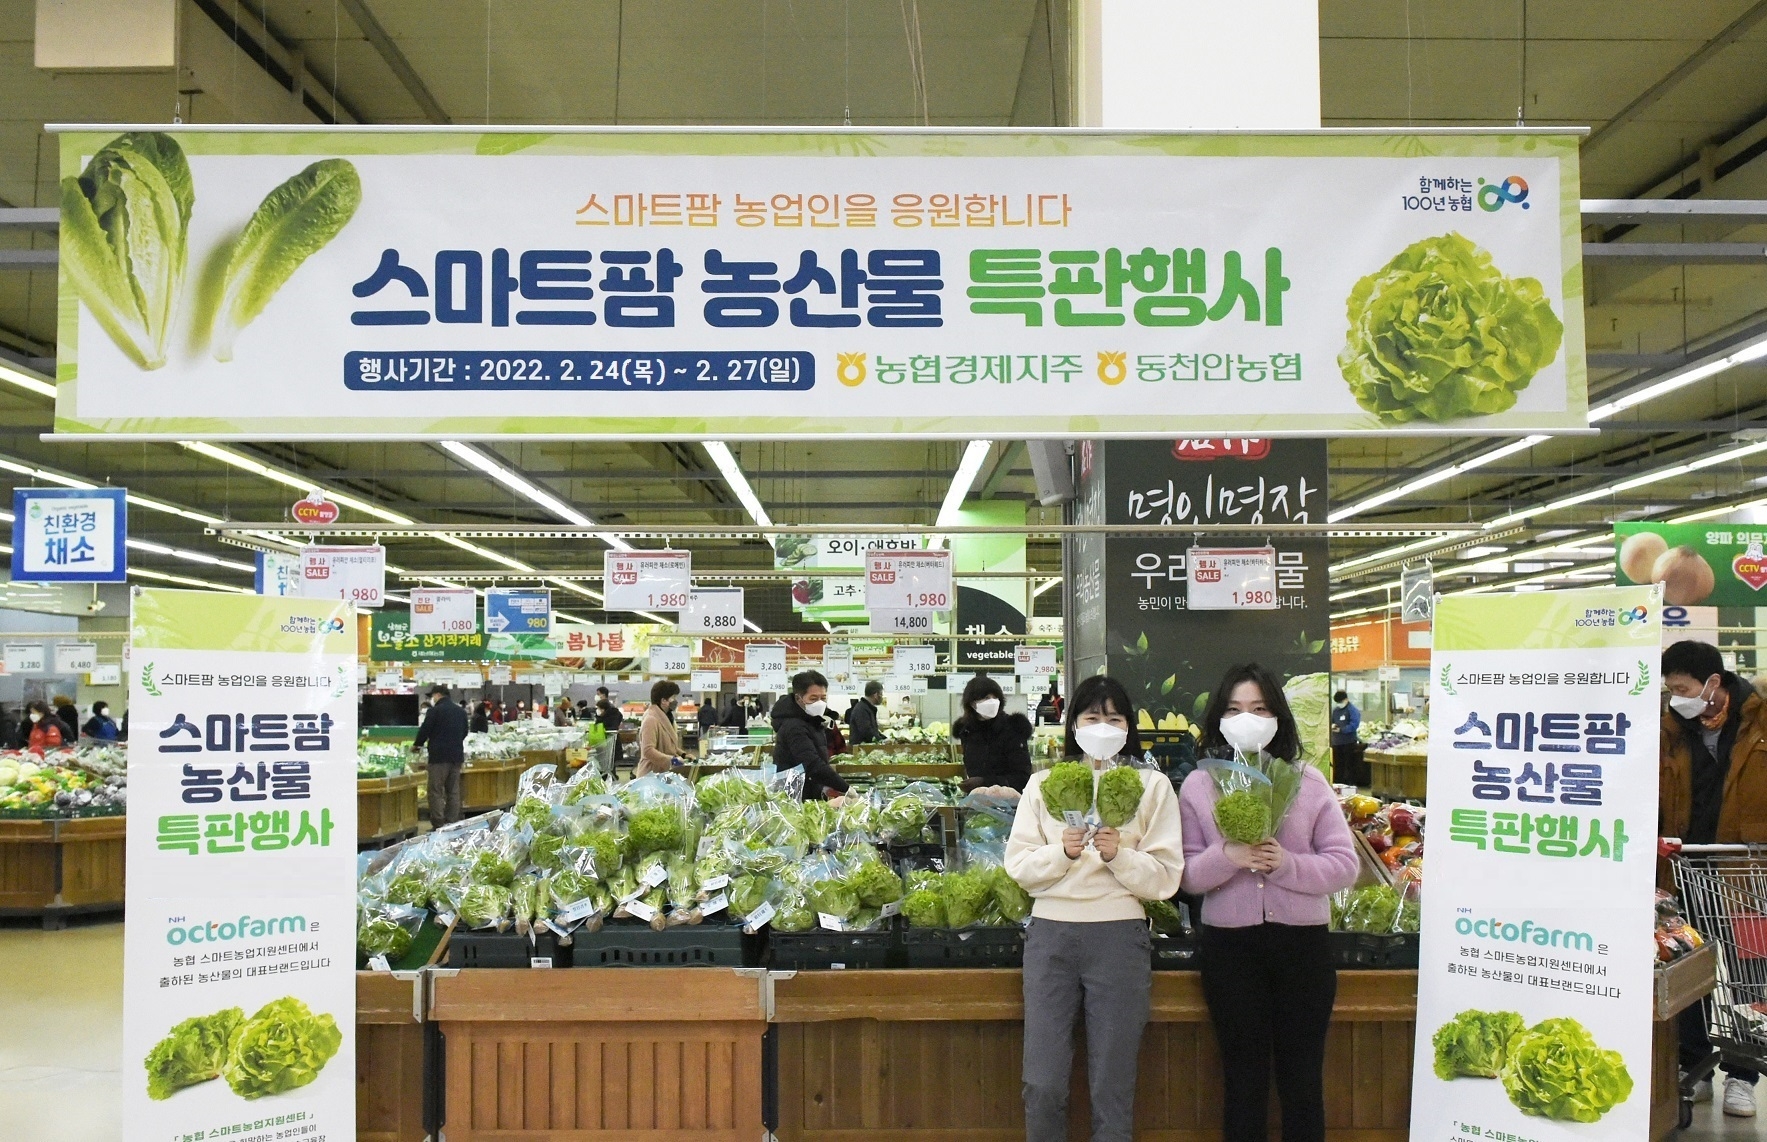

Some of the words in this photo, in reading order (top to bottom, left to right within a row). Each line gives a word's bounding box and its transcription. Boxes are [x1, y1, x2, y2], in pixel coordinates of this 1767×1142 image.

[1419, 176, 1472, 193] 함께하는
[575, 193, 722, 227] 스마트팜
[734, 193, 878, 228] 농업인을
[891, 193, 1072, 227] 응원합니다
[1402, 196, 1445, 211] 100년
[1448, 194, 1472, 211] 농협
[350, 248, 684, 328] 스마트팜
[701, 248, 945, 328] 농산물
[966, 246, 1291, 328] 특판행사
[359, 357, 456, 383] 행사기간
[480, 359, 550, 381] 2022.
[560, 359, 582, 381] 2.
[590, 358, 666, 386] 24(목)
[696, 359, 718, 381] 2.
[727, 357, 800, 384] 27(일)
[875, 354, 1083, 385] 농협경제지주
[1135, 352, 1302, 383] 동천안농협
[1128, 474, 1318, 527] 명인명작
[298, 508, 319, 517] CCTV
[44, 511, 96, 535] 친환경
[1705, 531, 1733, 544] 양파
[1737, 531, 1767, 544] 의무
[44, 536, 95, 565] 채소
[306, 568, 329, 577] SALE
[1196, 571, 1220, 580] SALE
[1739, 564, 1760, 573] CCTV
[871, 573, 894, 582] SALE
[340, 588, 379, 601] 1980
[648, 593, 687, 608] 1,980
[906, 593, 947, 607] 1,980
[1232, 590, 1273, 606] 1,980
[1137, 596, 1172, 610] 농민이
[1585, 608, 1615, 618] 함께하는
[441, 620, 473, 632] 1,080
[527, 618, 548, 628] 980
[703, 615, 737, 629] 8,880
[894, 616, 928, 630] 14,800
[423, 633, 482, 648] 산지직거래
[664, 661, 686, 671] 3,280
[760, 662, 782, 671] 3,280
[909, 663, 931, 672] 3,180
[161, 673, 214, 686] 스마트팜
[217, 674, 267, 687] 농업인을
[271, 675, 331, 688] 응원합니다
[1456, 672, 1506, 686] 스마트팜
[1508, 672, 1559, 686] 농업인을
[1563, 671, 1630, 686] 응원합니다
[158, 712, 334, 753] 스마트팜
[1453, 711, 1631, 755] 스마트팜
[180, 761, 311, 803] 농산물
[1471, 760, 1603, 806] 농산물
[156, 808, 334, 855] 특판행사
[1449, 808, 1630, 862] 특판행사
[168, 916, 186, 924] NH
[167, 915, 306, 945] octofarm
[310, 922, 320, 932] 은
[1455, 917, 1593, 952] octofarm
[1597, 943, 1609, 955] 은
[173, 955, 196, 968] 농협
[200, 941, 319, 964] 스마트농업지원센터에서
[1459, 946, 1480, 959] 농협
[1483, 950, 1607, 976] 스마트농업지원센터에서
[159, 974, 194, 988] 출하된
[198, 968, 242, 983] 농산물의
[246, 957, 331, 977] 대표브랜드입니다
[1447, 962, 1477, 977] 출하된
[1481, 967, 1523, 984] 농산물의
[1527, 974, 1621, 999] 대표브랜드입니다
[208, 1111, 306, 1138] 스마트농업지원센터
[276, 1123, 317, 1140] 농업인들이
[1460, 1122, 1481, 1136] 농협
